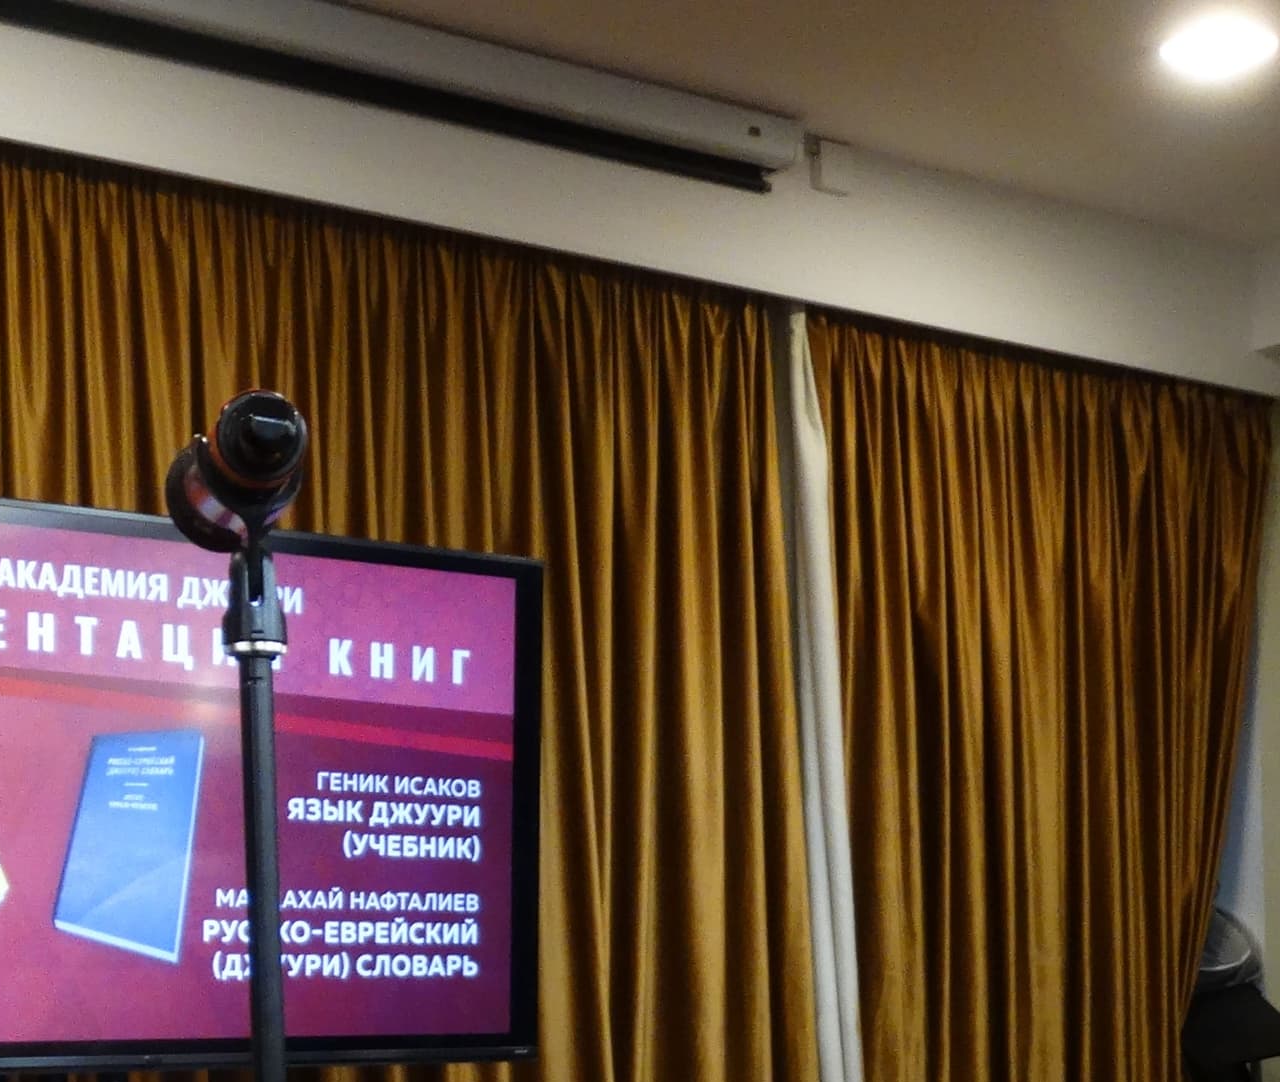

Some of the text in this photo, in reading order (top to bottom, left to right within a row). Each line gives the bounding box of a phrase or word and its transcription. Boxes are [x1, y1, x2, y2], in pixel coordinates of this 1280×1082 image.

[176, 577, 303, 614] ДЖИ
[328, 638, 471, 685] КНИГ
[317, 772, 481, 798] ГЕНИК ИСАКОВ
[287, 798, 481, 828] ЯЗЫК ДЖУУРИ
[343, 830, 481, 862] (УЧЕБНИК)
[215, 886, 480, 912] МААХАЙ НАФТАЛИЕВ
[202, 917, 478, 945] РУСО-ЕВРЕЙСКИЙ
[212, 951, 479, 981] (ДУРИ) СЛОВАРЬ
